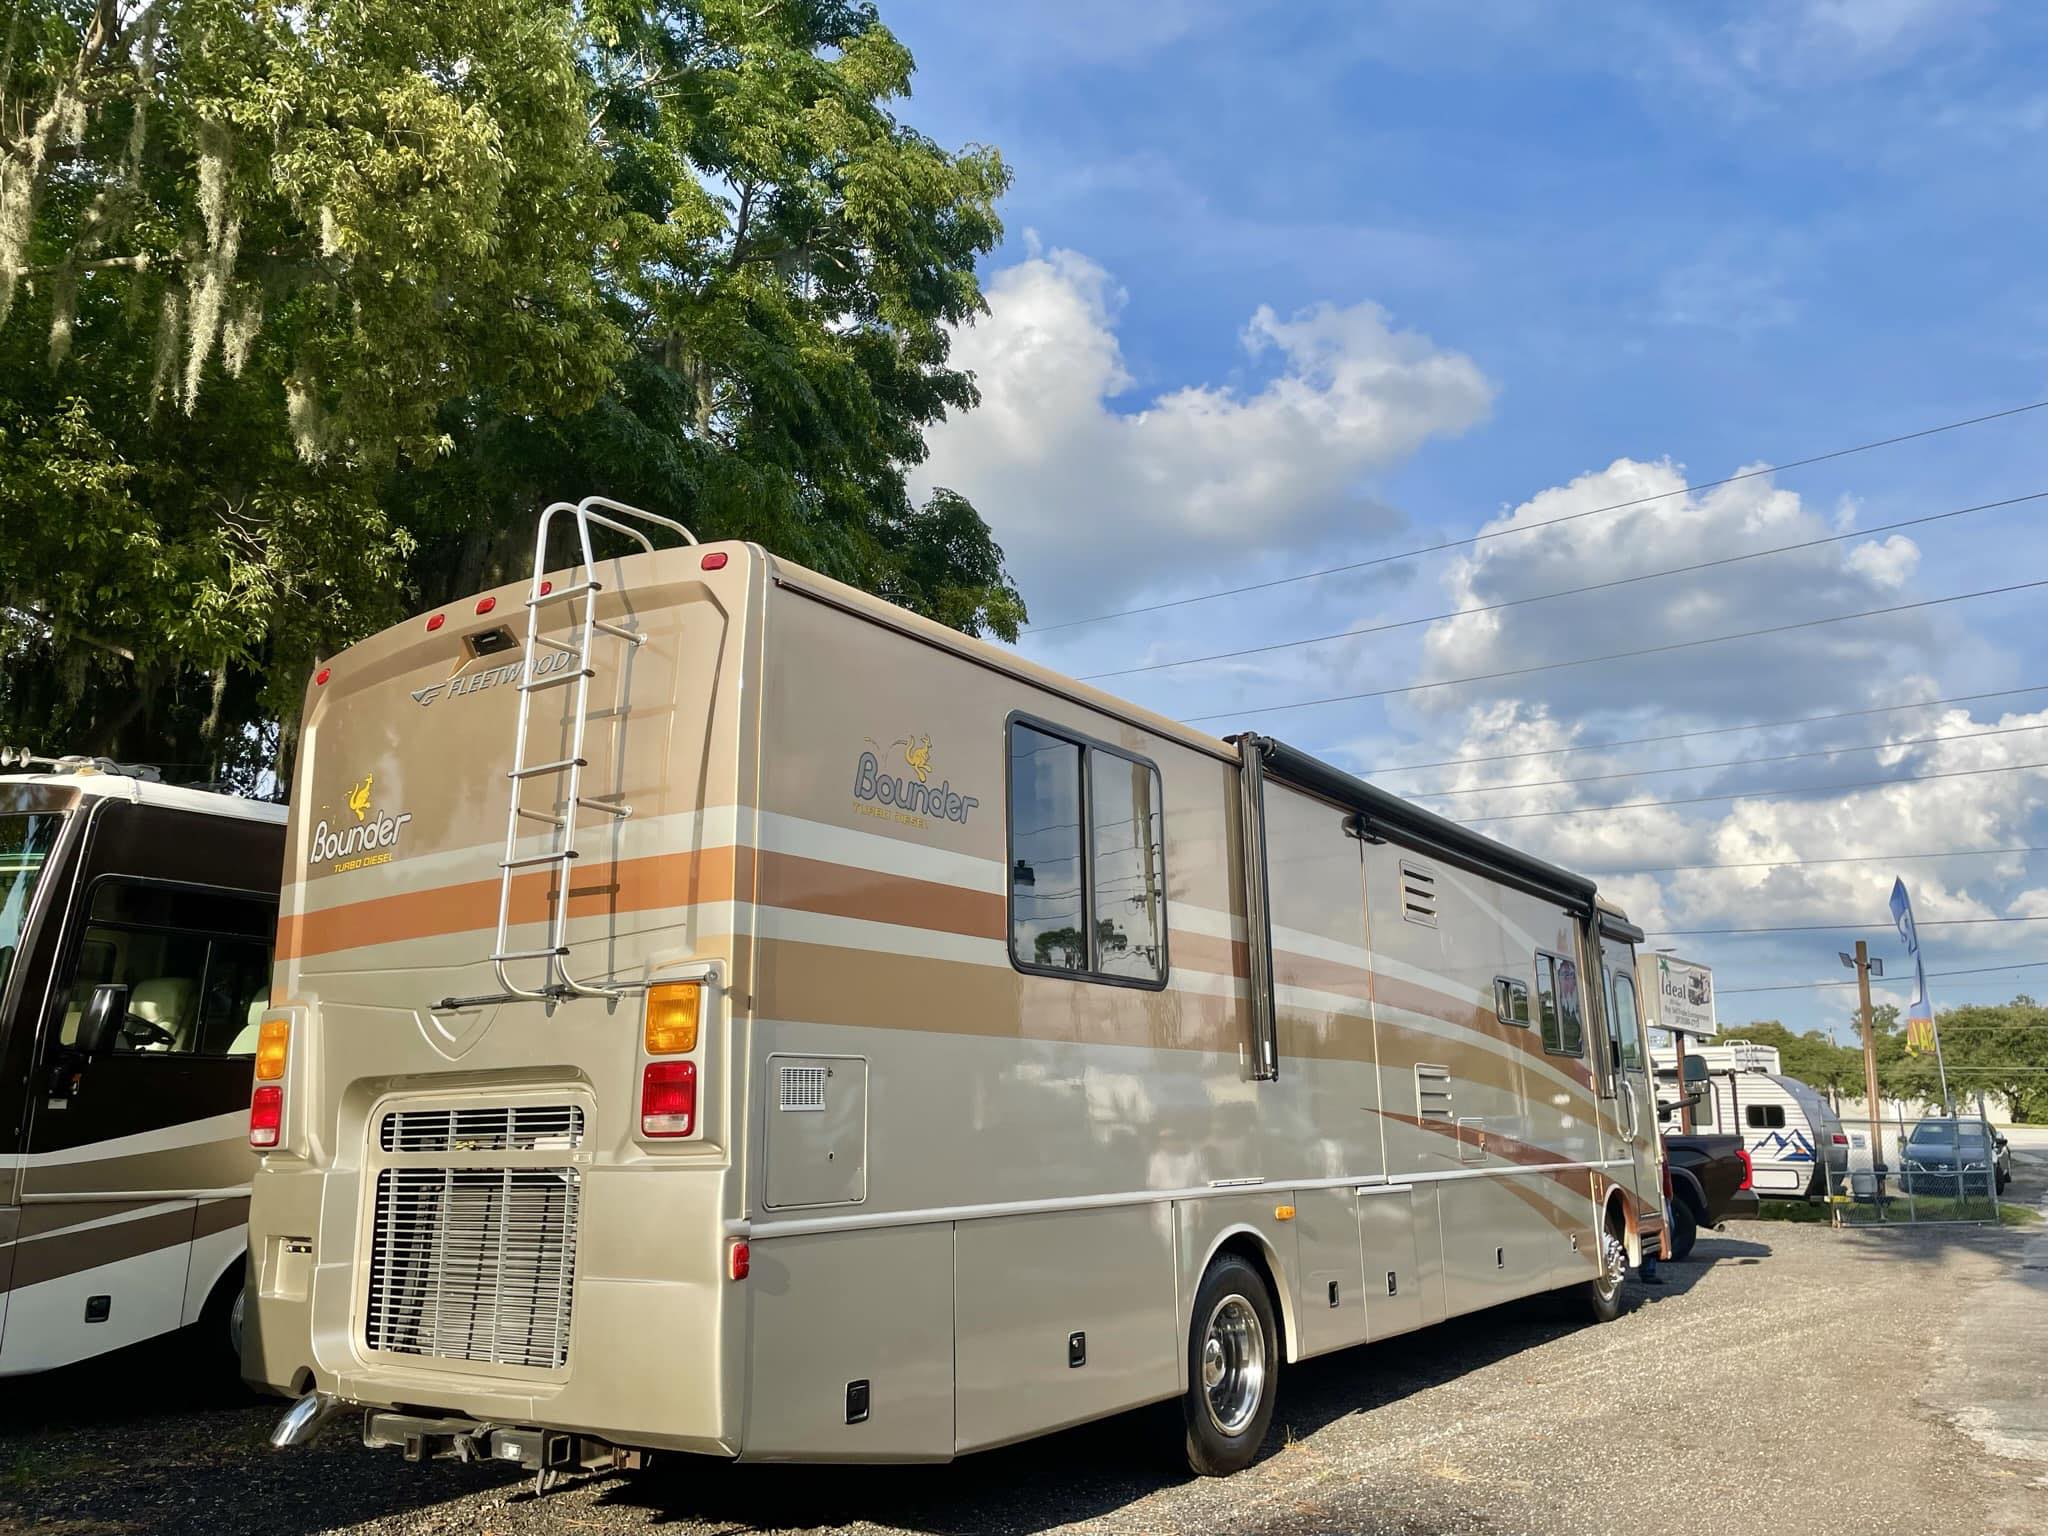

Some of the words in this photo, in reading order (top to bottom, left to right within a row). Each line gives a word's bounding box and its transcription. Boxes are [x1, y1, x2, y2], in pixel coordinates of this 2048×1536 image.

[854, 752, 979, 824] Bounder
[310, 810, 413, 863] Bounder
[334, 858, 362, 873] TURBO
[363, 852, 393, 867] DIESEL
[1661, 971, 1687, 999] Ideal
